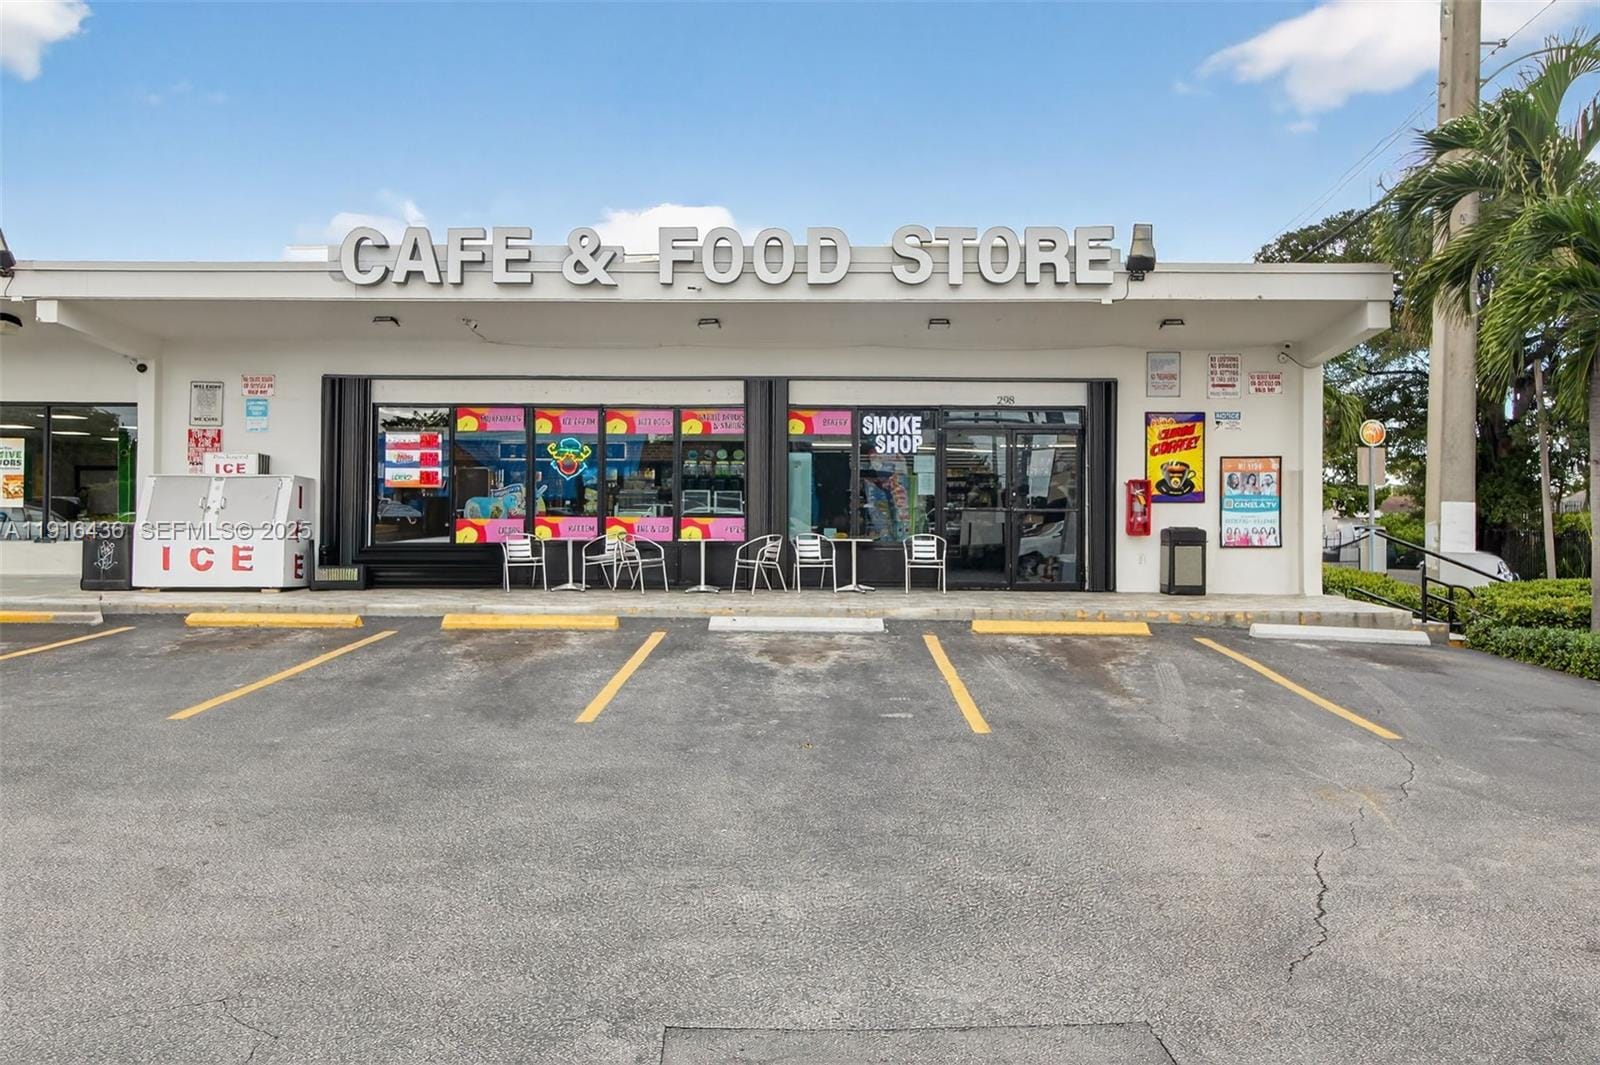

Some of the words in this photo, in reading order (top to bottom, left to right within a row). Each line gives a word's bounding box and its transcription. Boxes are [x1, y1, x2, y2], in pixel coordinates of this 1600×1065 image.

[340, 226, 534, 287] CAFE
[562, 227, 618, 287] &
[658, 226, 852, 286] FOOD
[890, 225, 1116, 286] STORE
[862, 415, 922, 435] SMOKE
[874, 434, 923, 455] SHOP
[215, 463, 246, 474] ICE
[161, 544, 255, 573] ICE
